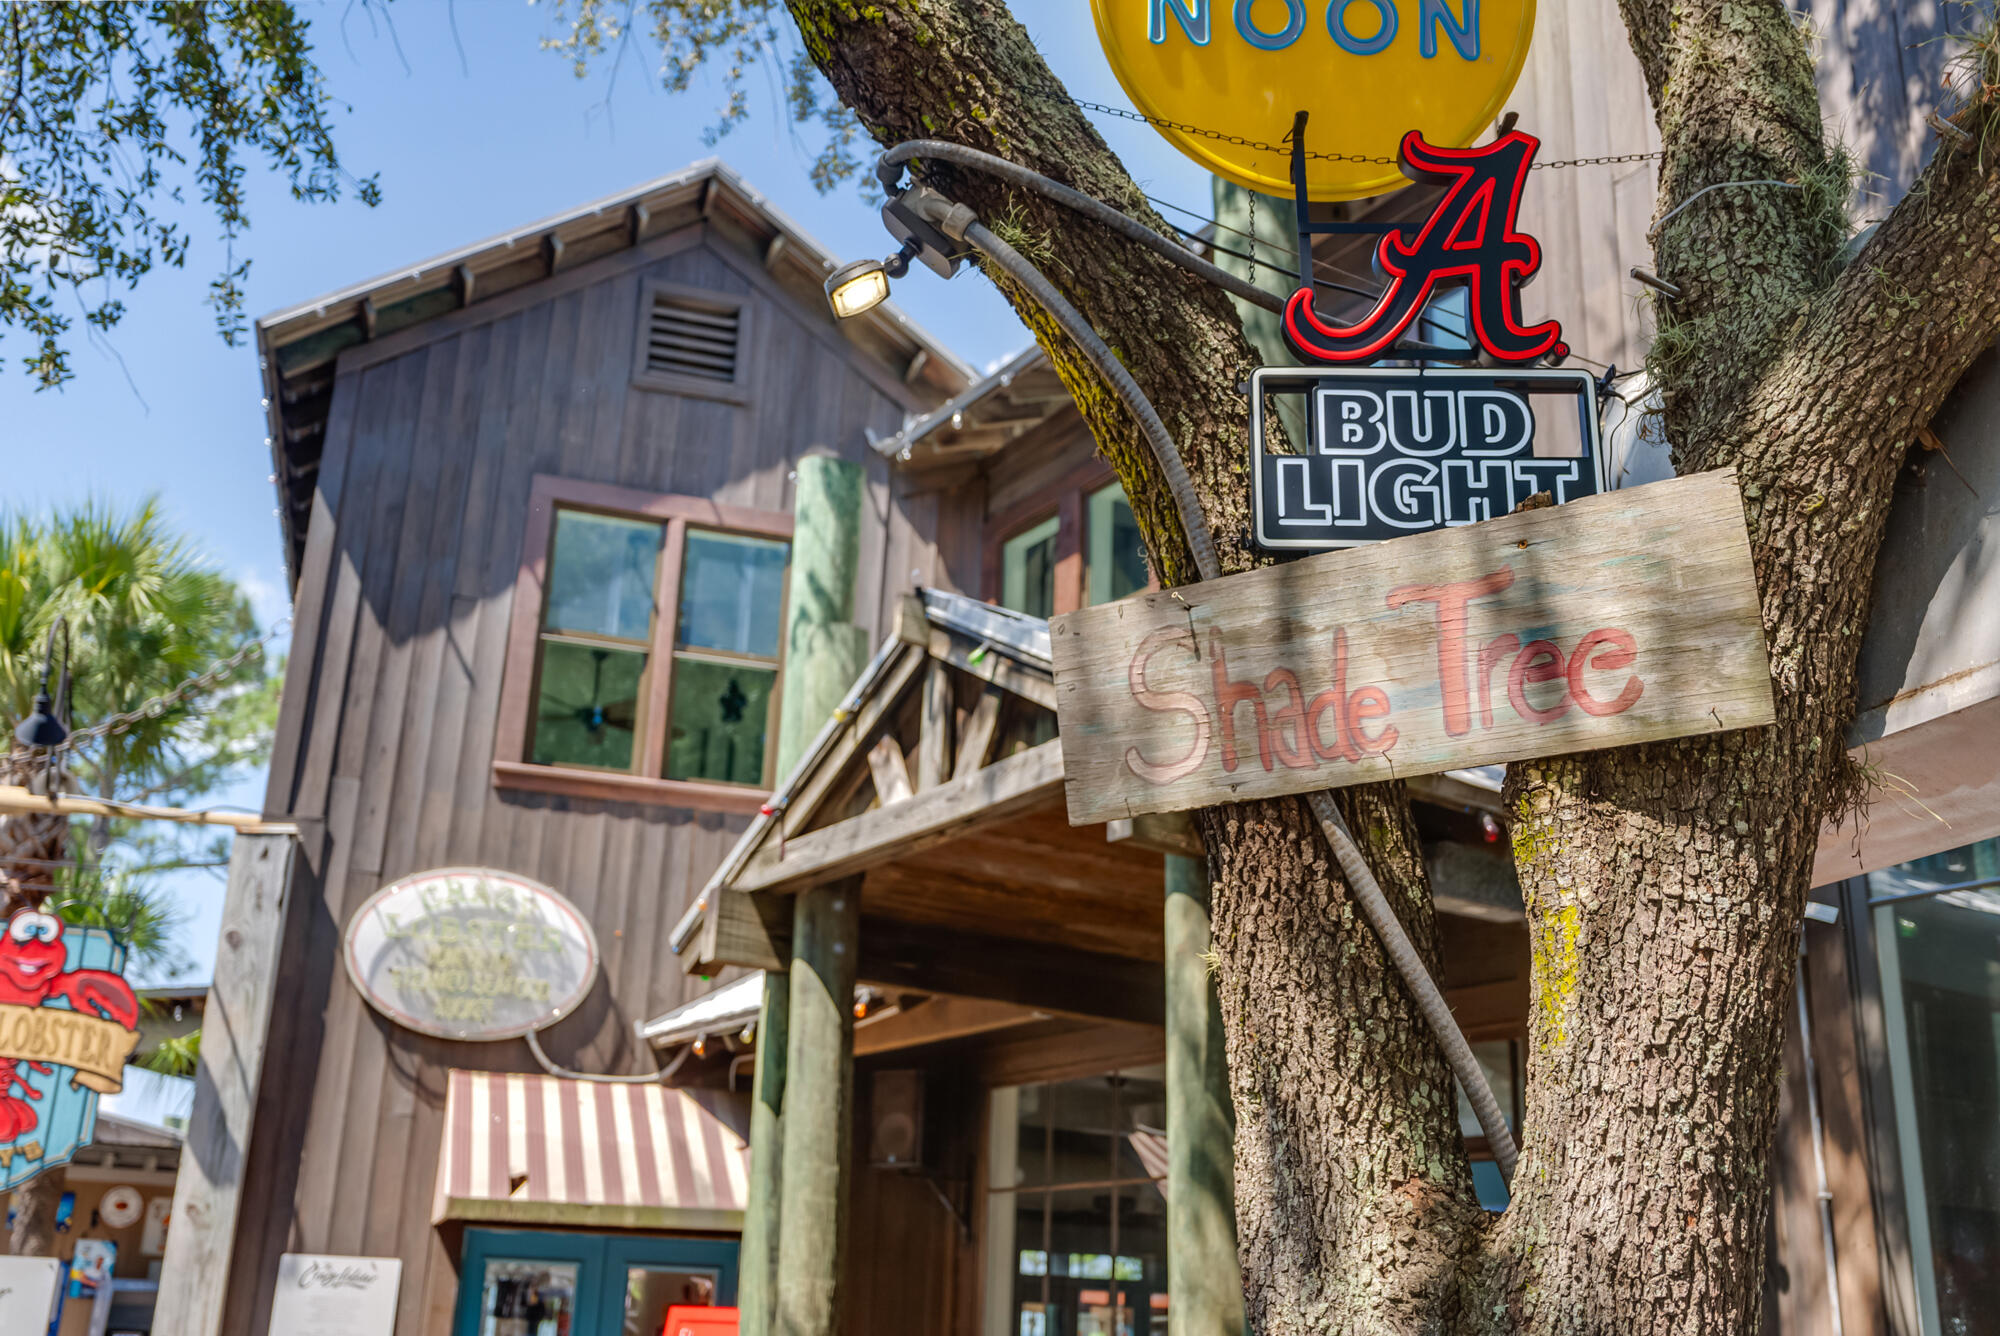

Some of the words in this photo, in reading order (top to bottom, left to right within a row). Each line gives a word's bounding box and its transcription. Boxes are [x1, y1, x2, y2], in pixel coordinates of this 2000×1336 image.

[1147, 0, 1482, 61] NOON
[1283, 129, 1561, 362] A
[1317, 389, 1533, 457] BUD
[1276, 457, 1579, 529] LIGHT
[1126, 624, 1400, 786] Shade
[1386, 565, 1646, 738] Tree
